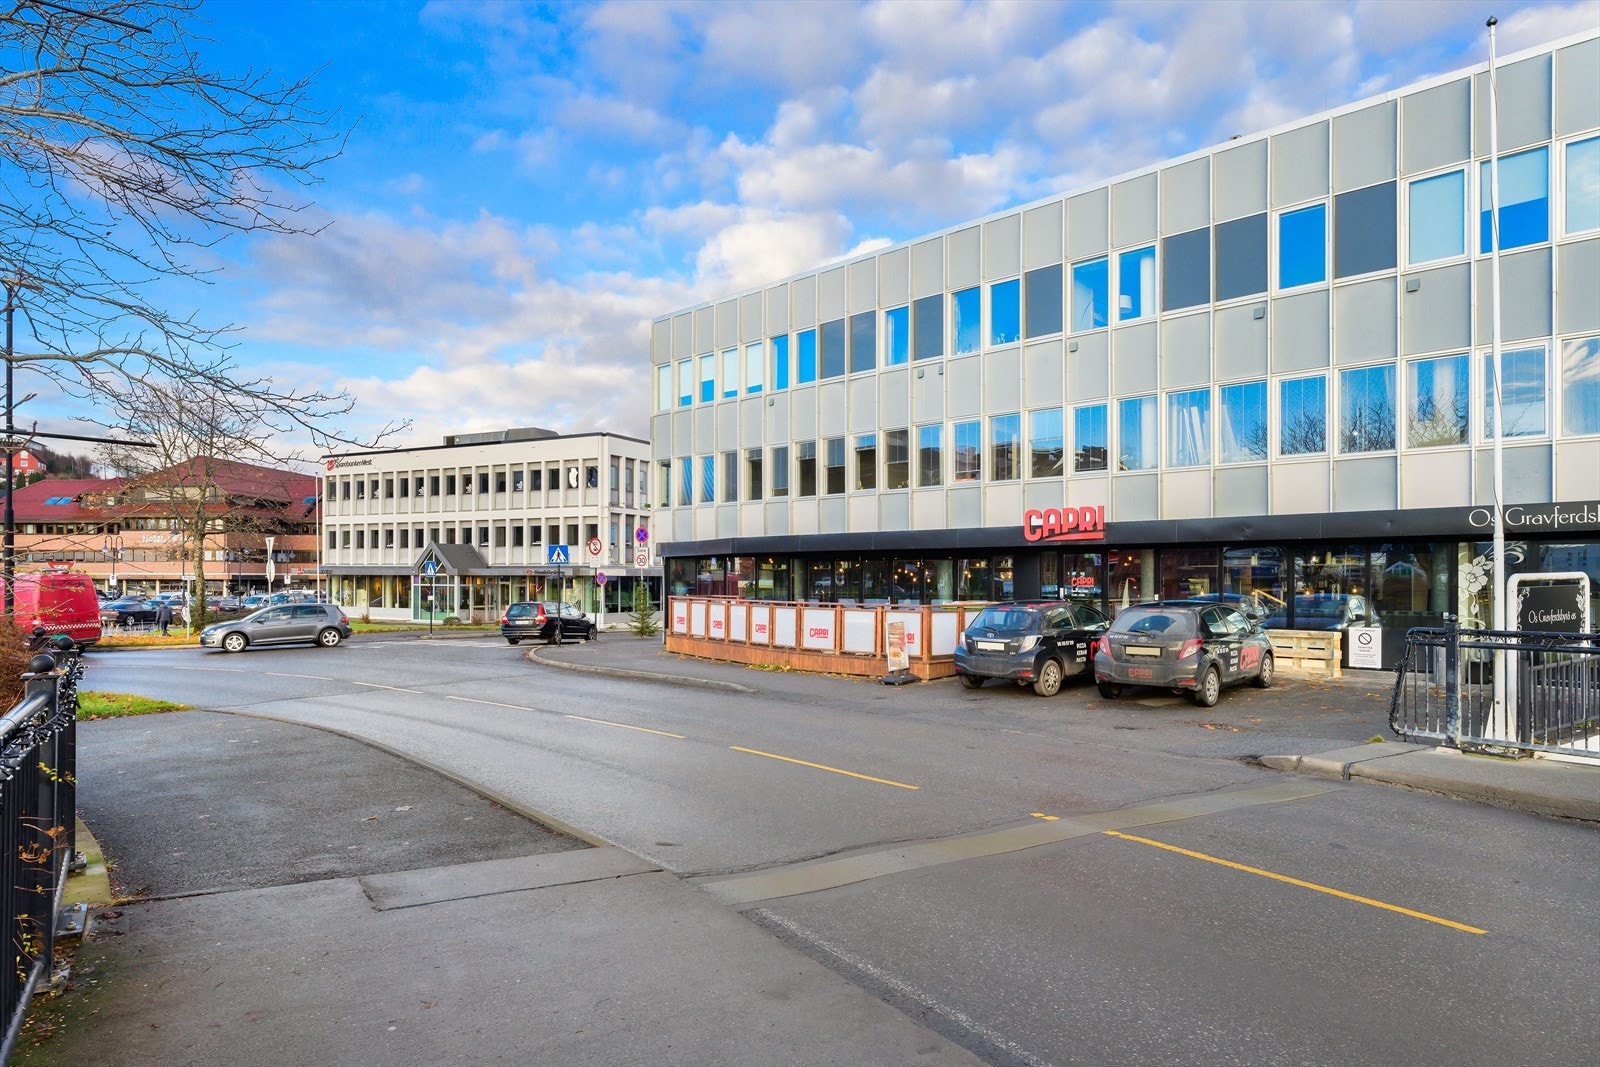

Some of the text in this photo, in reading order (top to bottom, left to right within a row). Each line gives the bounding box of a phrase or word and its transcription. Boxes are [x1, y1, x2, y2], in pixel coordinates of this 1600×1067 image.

[1505, 504, 1600, 528] Gravferds
[1024, 506, 1105, 541] CAPRI
[1071, 577, 1095, 587] CAPRI
[1529, 610, 1538, 623] Os
[755, 624, 767, 633] CAPRI
[809, 628, 829, 638] CAPRI
[1128, 668, 1153, 678] CAPRI
